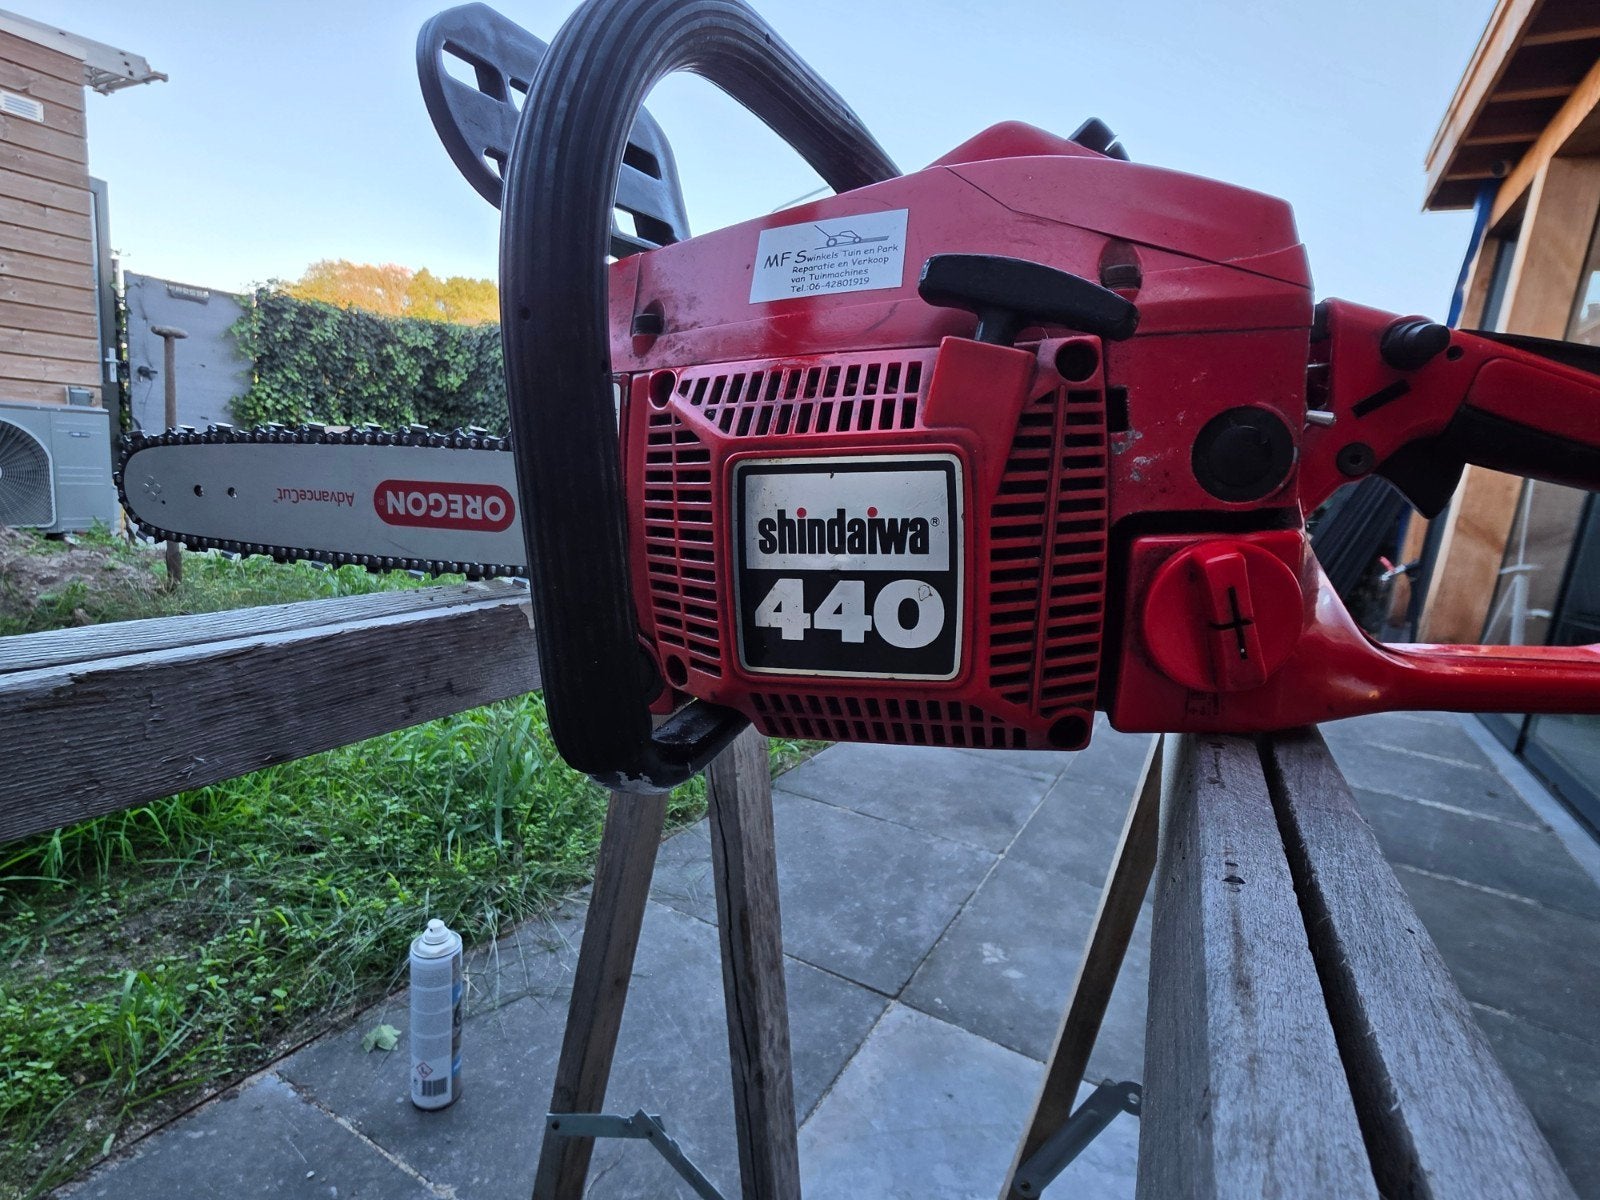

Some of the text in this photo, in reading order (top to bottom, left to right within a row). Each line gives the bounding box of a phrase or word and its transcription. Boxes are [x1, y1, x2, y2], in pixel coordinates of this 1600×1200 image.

[764, 252, 792, 269] MF
[794, 250, 839, 263] Swinkels
[842, 249, 861, 257] Tuin
[877, 244, 898, 253] Park
[792, 262, 836, 274] Reparatie
[852, 256, 889, 265] Verkoop
[809, 268, 869, 280] Tuinmachines
[386, 490, 507, 522] OREGON
[755, 578, 945, 649] 440
